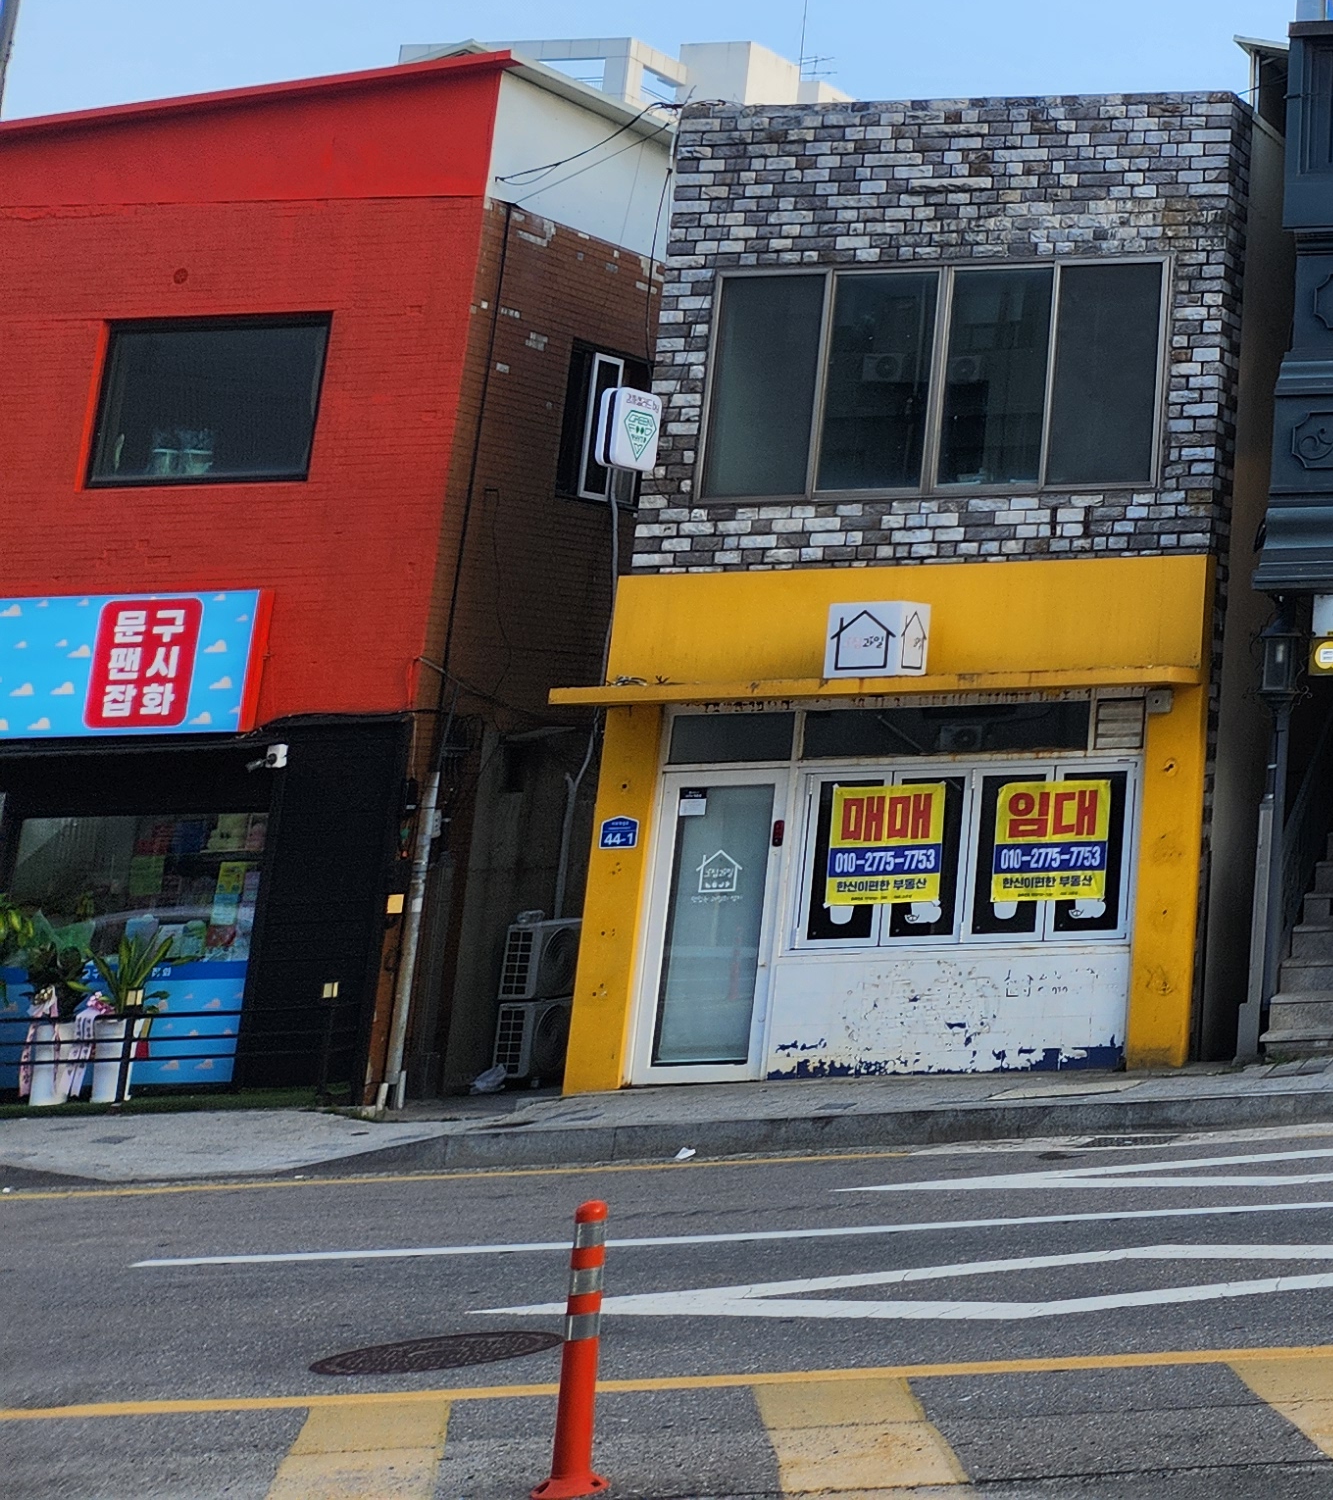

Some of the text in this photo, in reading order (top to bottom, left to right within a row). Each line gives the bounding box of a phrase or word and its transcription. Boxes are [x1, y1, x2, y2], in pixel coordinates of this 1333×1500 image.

[114, 609, 185, 643] 문구
[108, 646, 180, 680] 팬시
[102, 683, 175, 717] 잡화
[841, 793, 933, 842] 매매
[1008, 790, 1098, 838] 임대
[604, 833, 633, 845] 44-1
[835, 849, 935, 873] 010-2775-7753
[1001, 846, 1100, 869] 010-2775-7753
[837, 878, 927, 893] 한신이편한 부동산
[1059, 875, 1092, 888] 부동산
